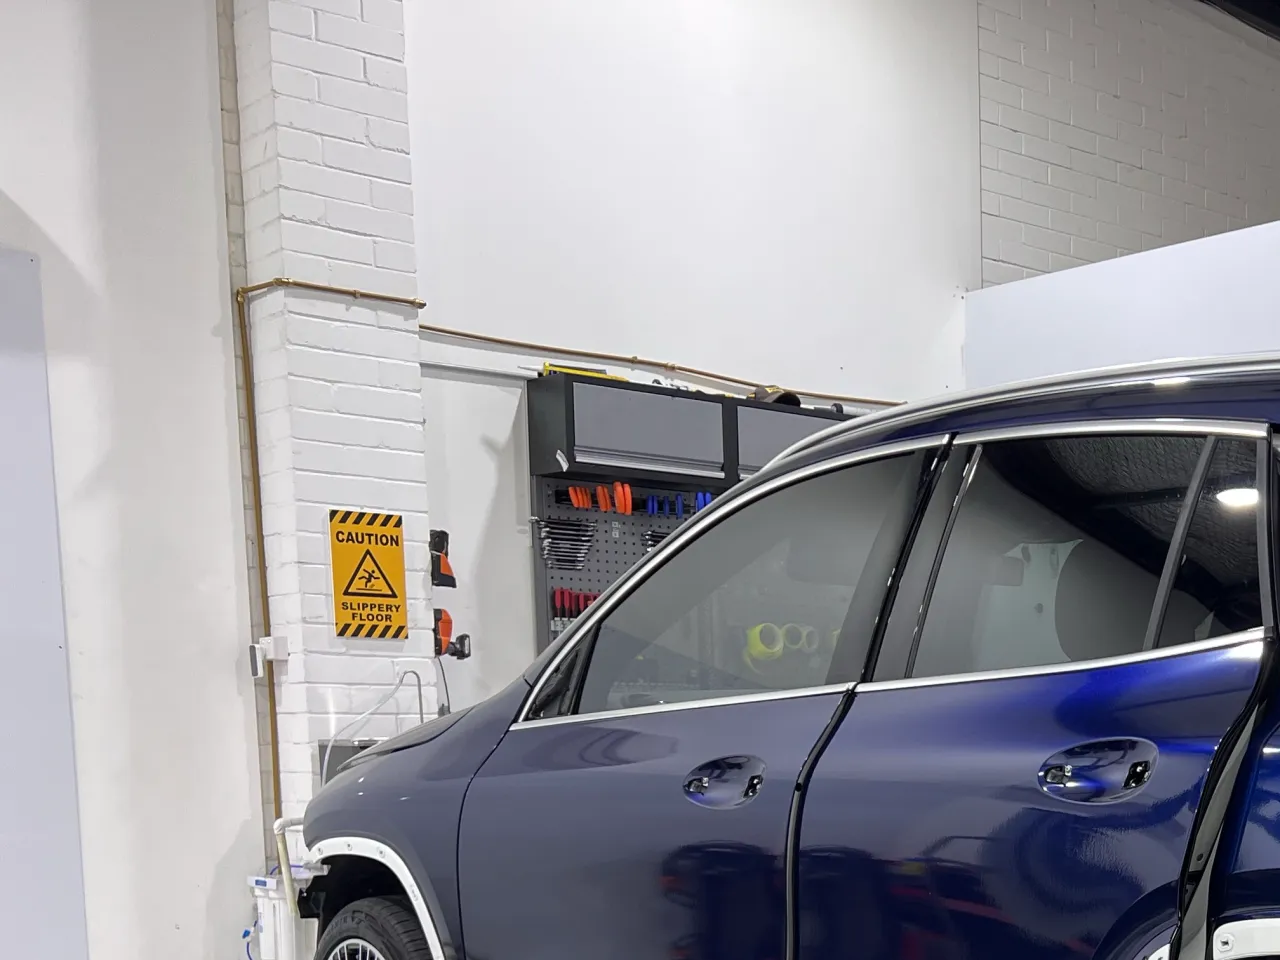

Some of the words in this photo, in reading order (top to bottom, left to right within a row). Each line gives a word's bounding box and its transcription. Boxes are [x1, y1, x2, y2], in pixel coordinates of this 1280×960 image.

[335, 530, 400, 547] CAUTION
[341, 601, 401, 613] SLIPPERY
[351, 612, 393, 623] FLOOR
